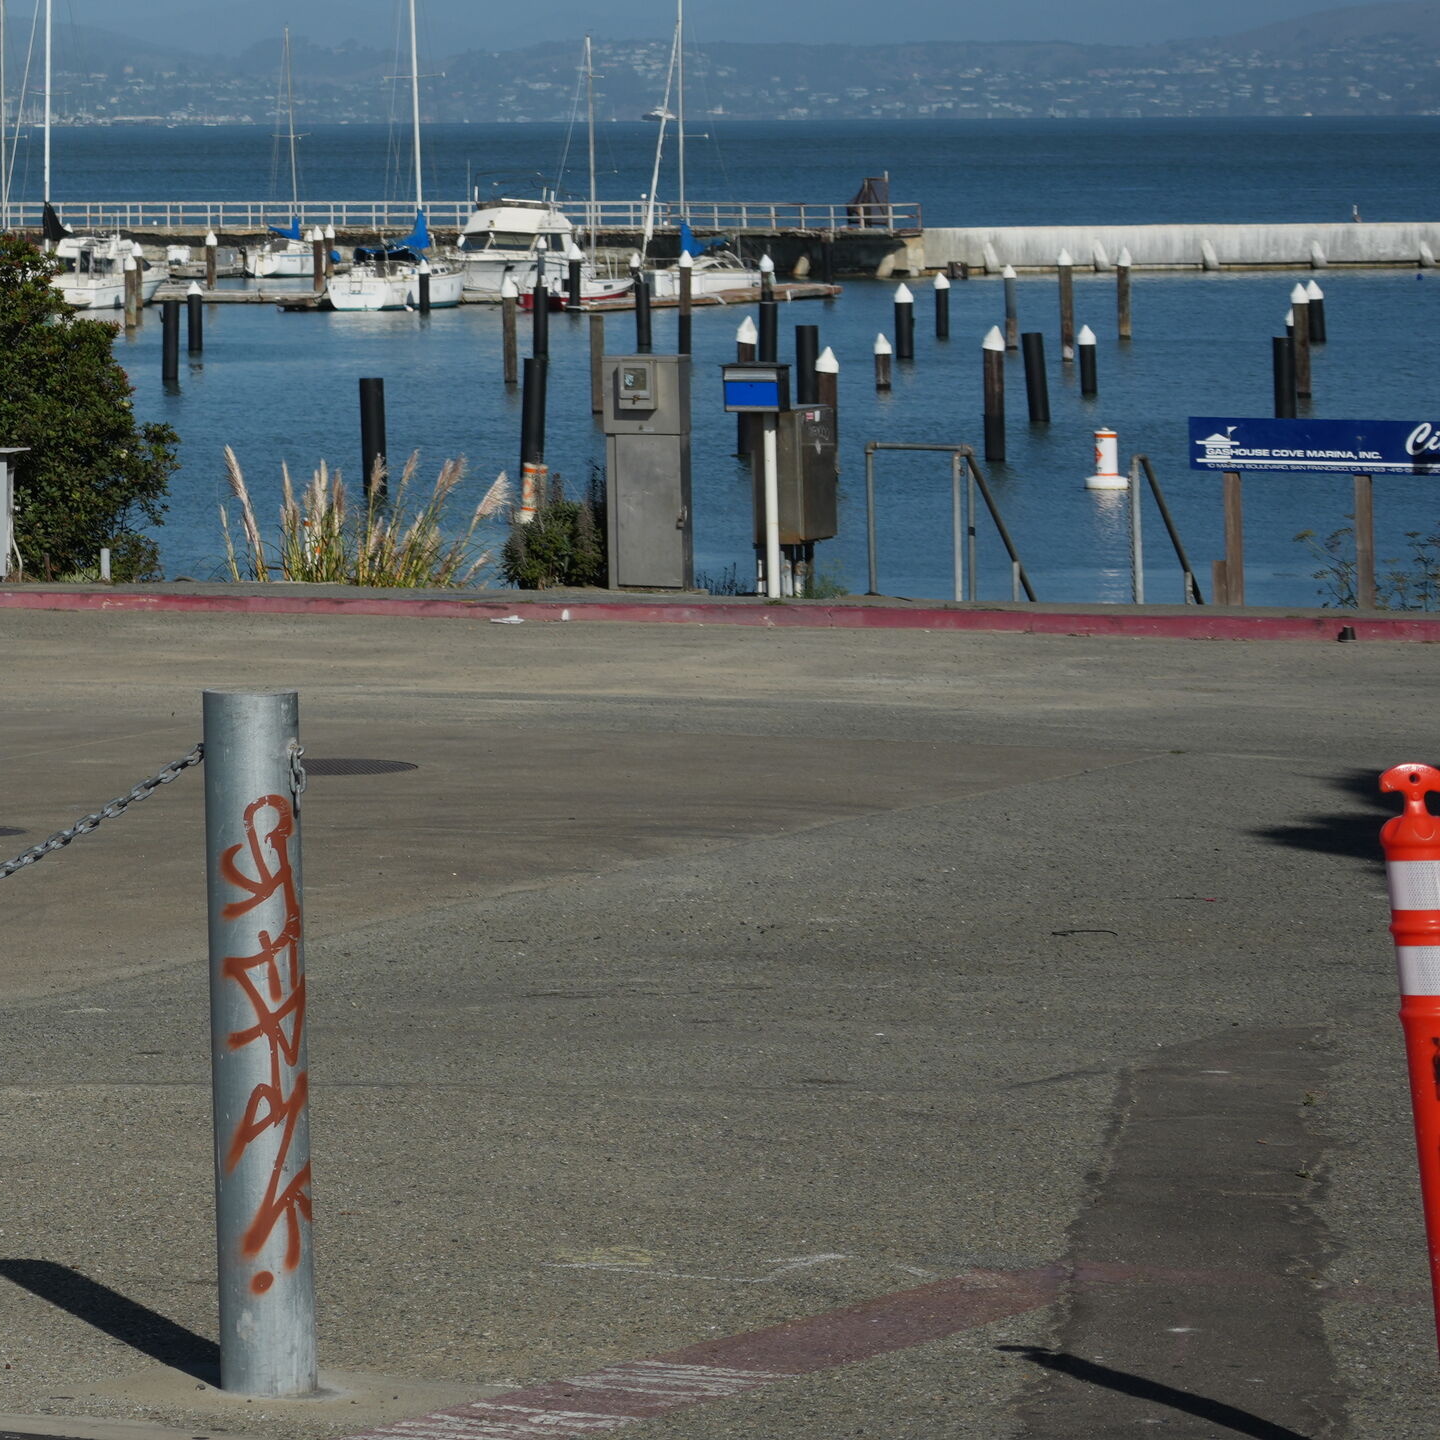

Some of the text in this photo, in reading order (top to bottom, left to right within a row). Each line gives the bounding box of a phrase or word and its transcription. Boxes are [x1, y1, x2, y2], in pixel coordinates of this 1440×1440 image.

[1206, 448, 1382, 460] GASHOUSE COVE MARINA, INC.
